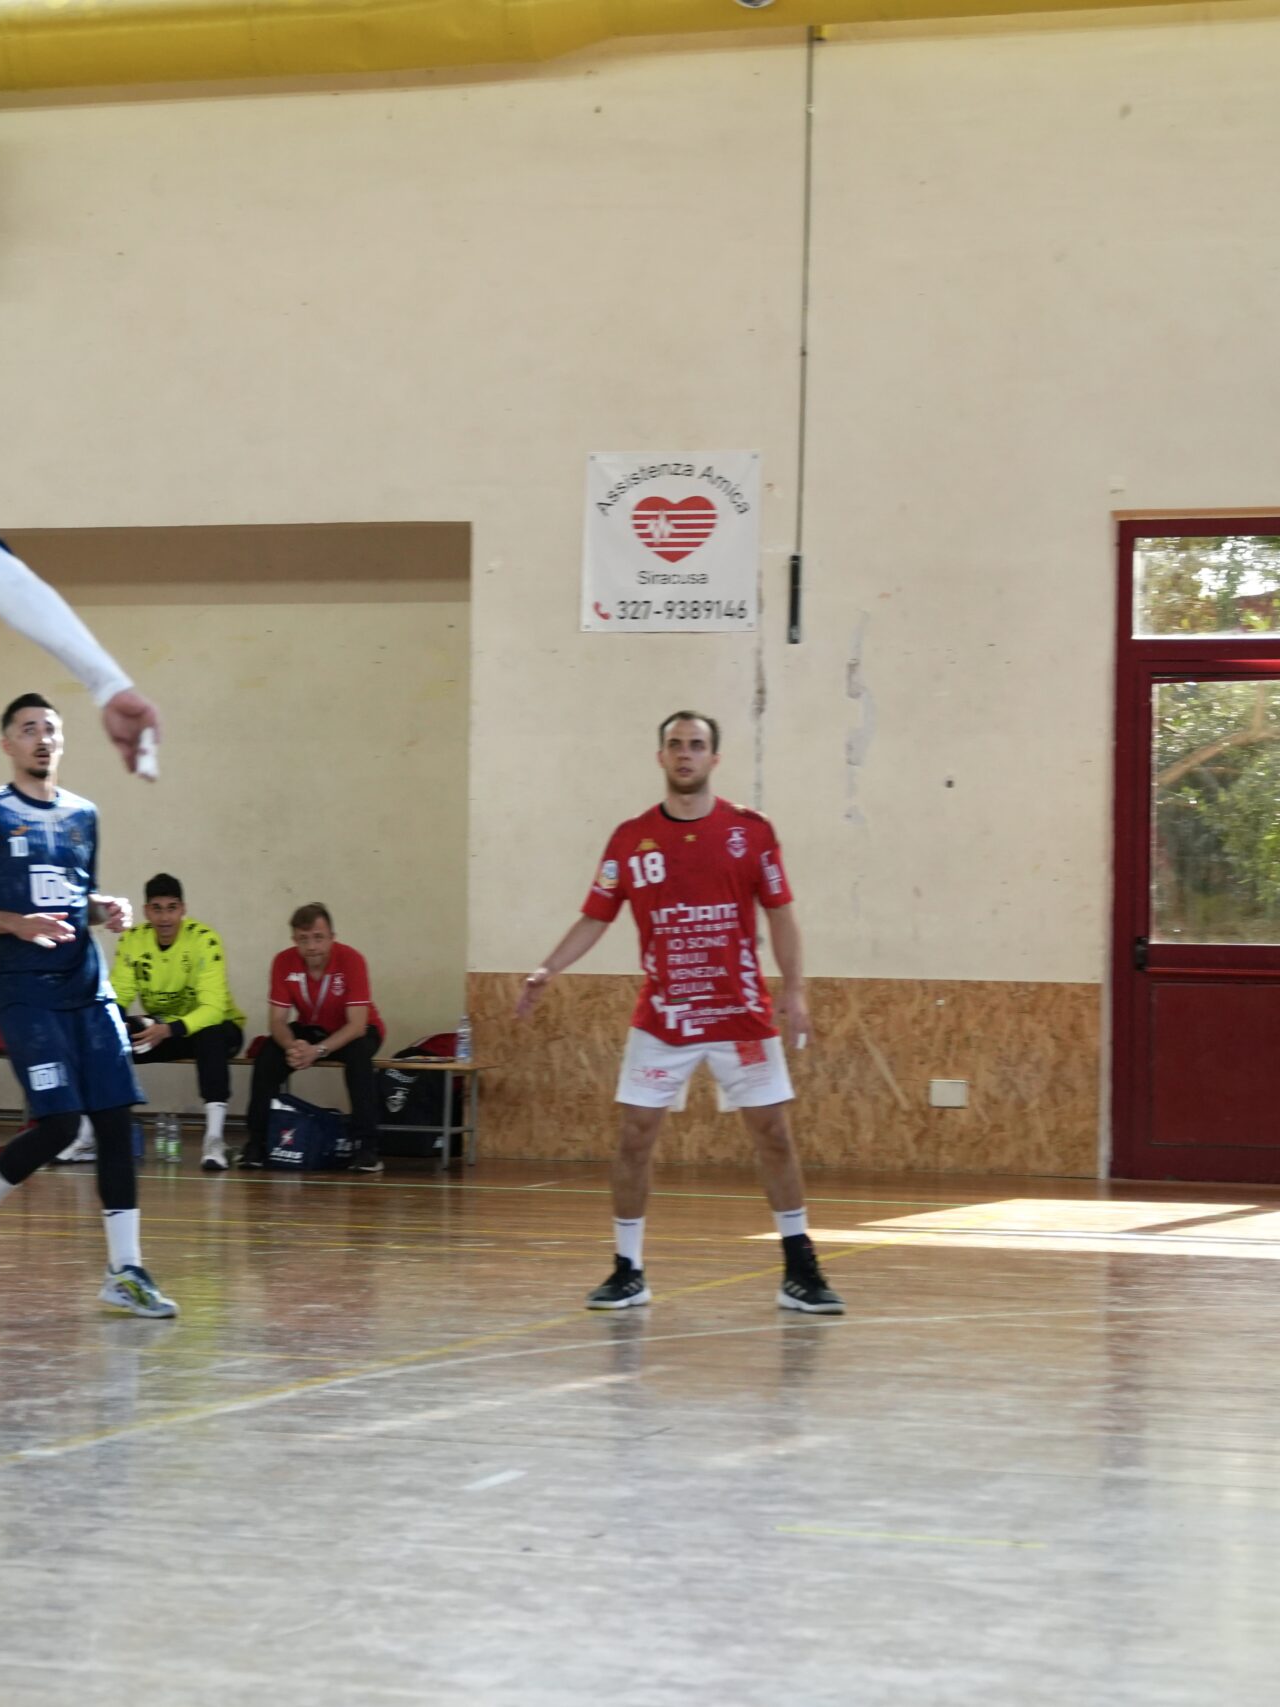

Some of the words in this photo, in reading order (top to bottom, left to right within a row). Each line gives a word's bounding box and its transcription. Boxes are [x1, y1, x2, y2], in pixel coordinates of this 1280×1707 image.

[596, 463, 695, 516] Assistenza
[697, 465, 751, 515] Amica
[636, 570, 709, 585] Siracusa
[616, 600, 749, 620] 327-9389146
[627, 851, 666, 888] 18
[687, 935, 729, 949] SONO
[668, 966, 729, 980] VENEZIA
[668, 981, 716, 996] GIULIA
